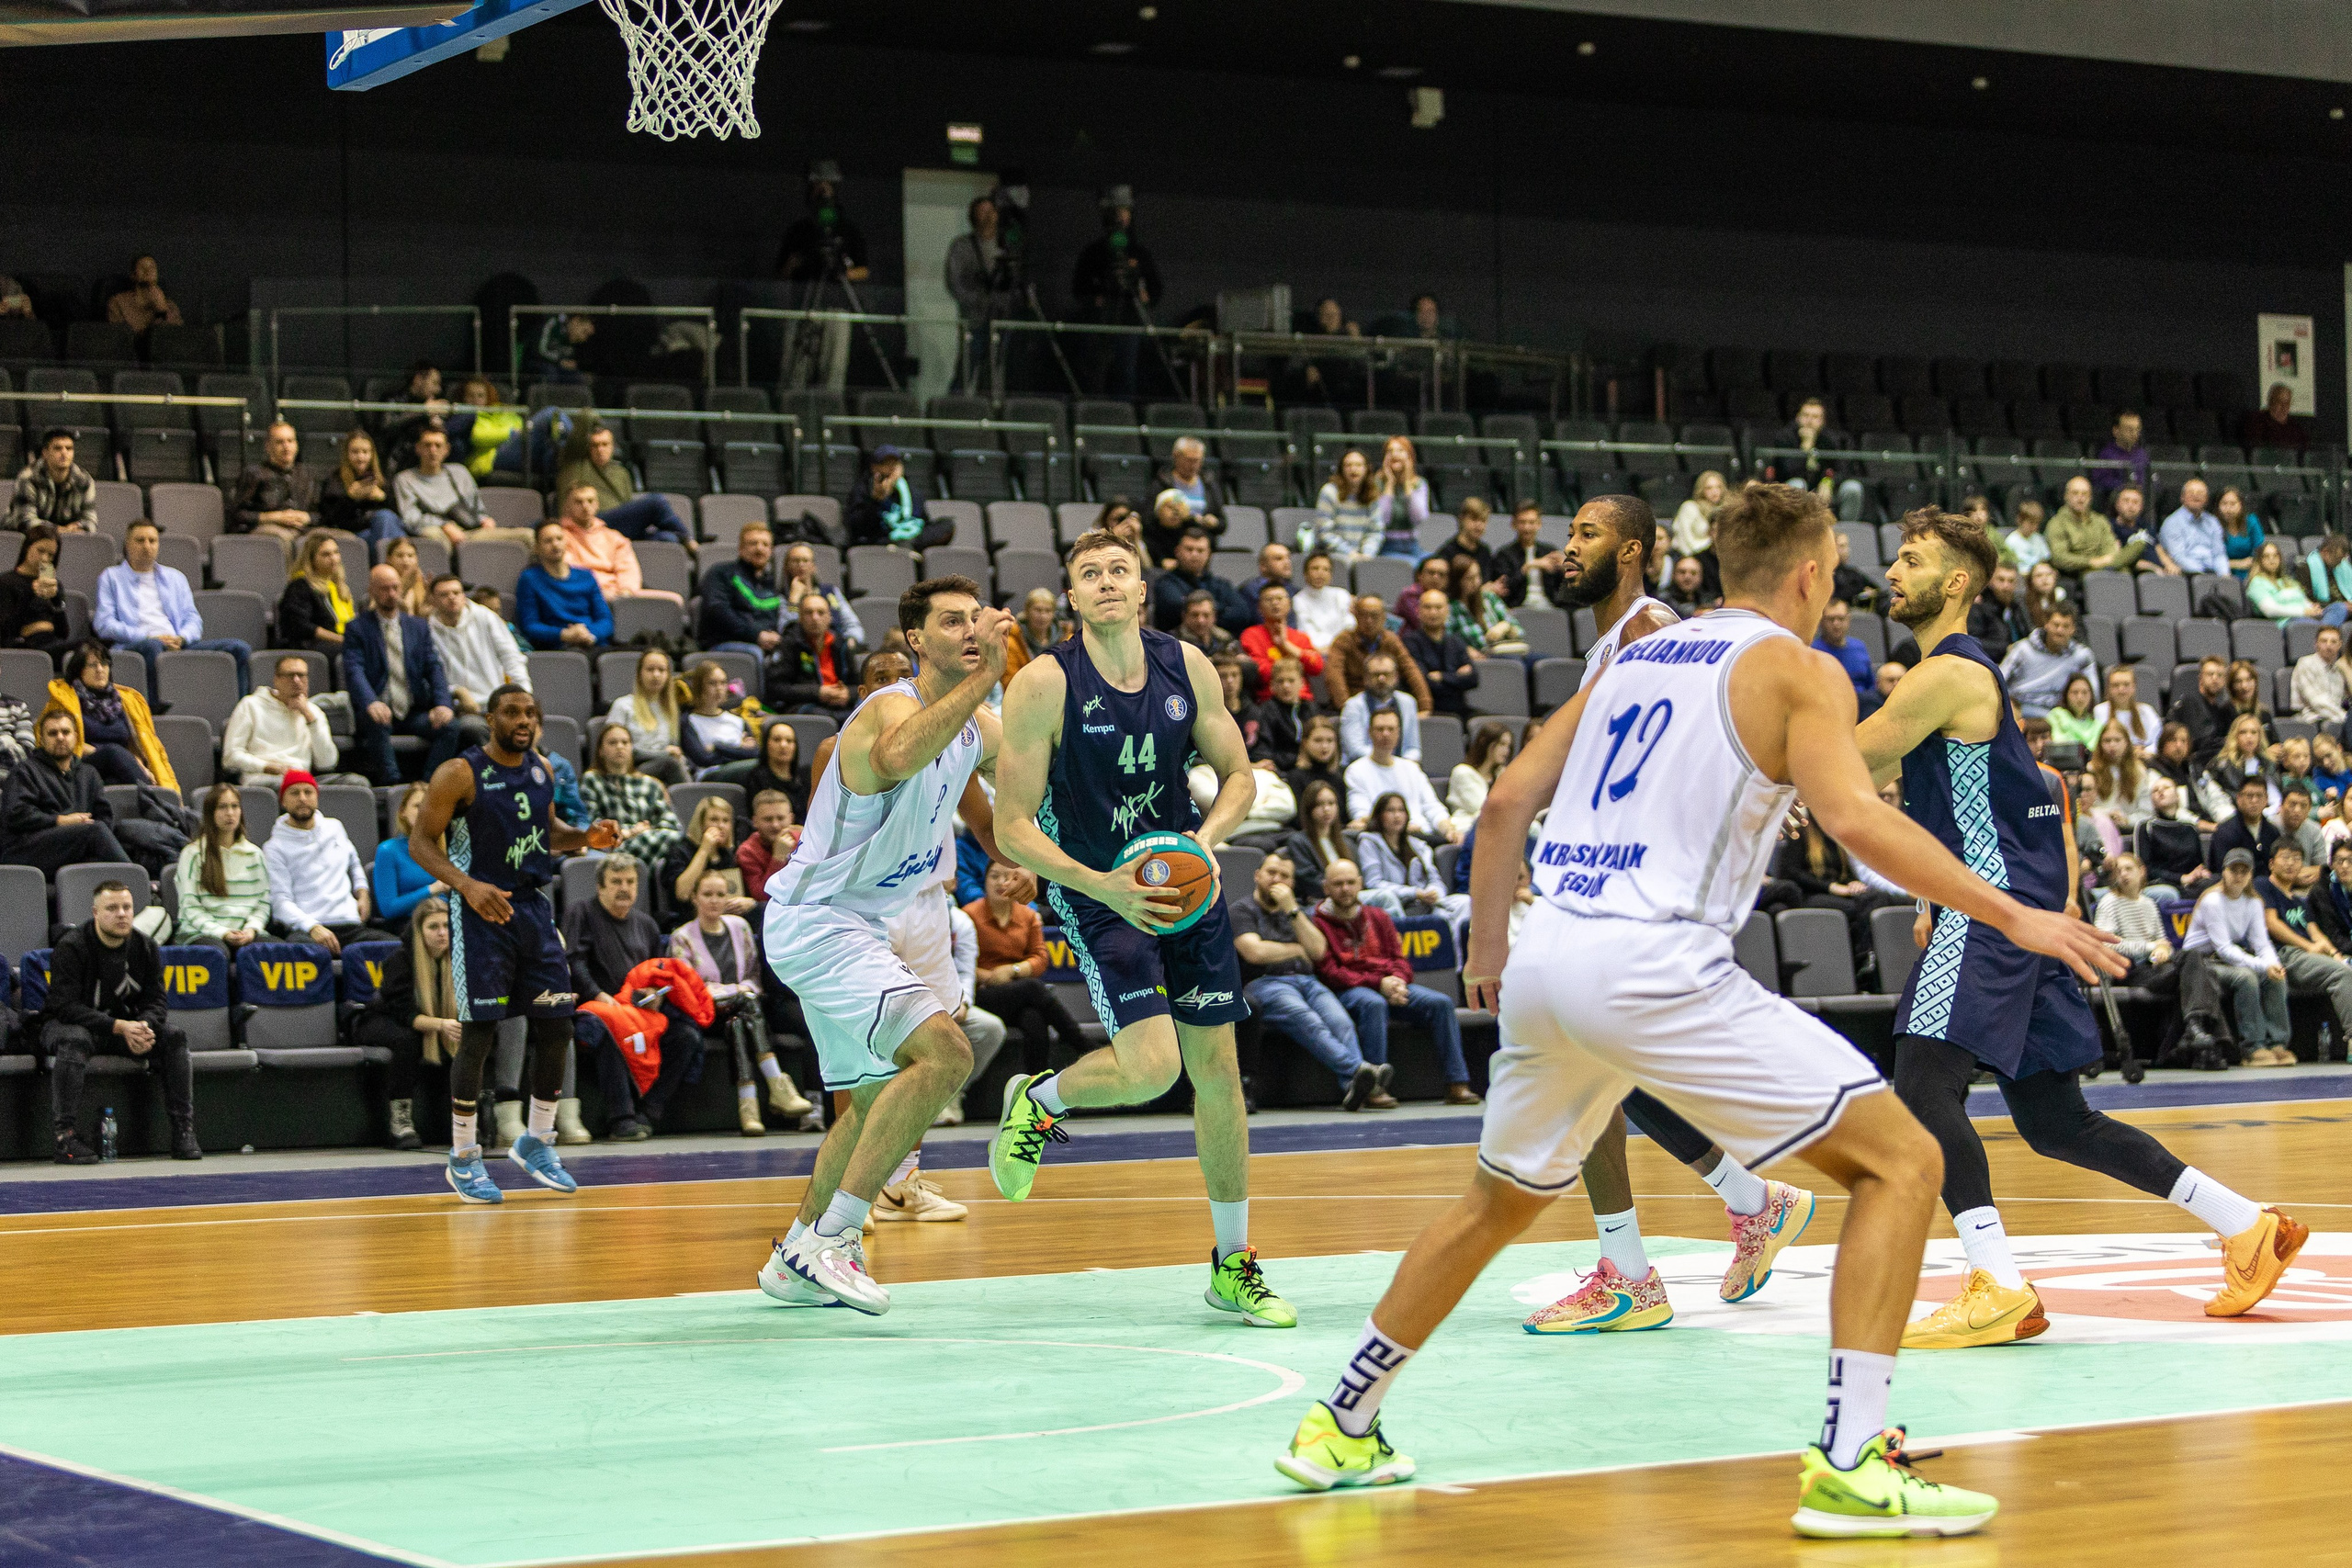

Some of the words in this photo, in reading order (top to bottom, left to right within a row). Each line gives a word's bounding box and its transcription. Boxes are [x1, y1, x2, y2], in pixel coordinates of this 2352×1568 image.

[1082, 724, 1115, 734] Kempa
[1117, 733, 1157, 773] 44
[1590, 697, 1672, 811] 12
[514, 792, 531, 820] 3
[1123, 836, 1179, 859] SIBUR
[260, 961, 319, 991] VIP
[1118, 987, 1155, 1003] Kempa
